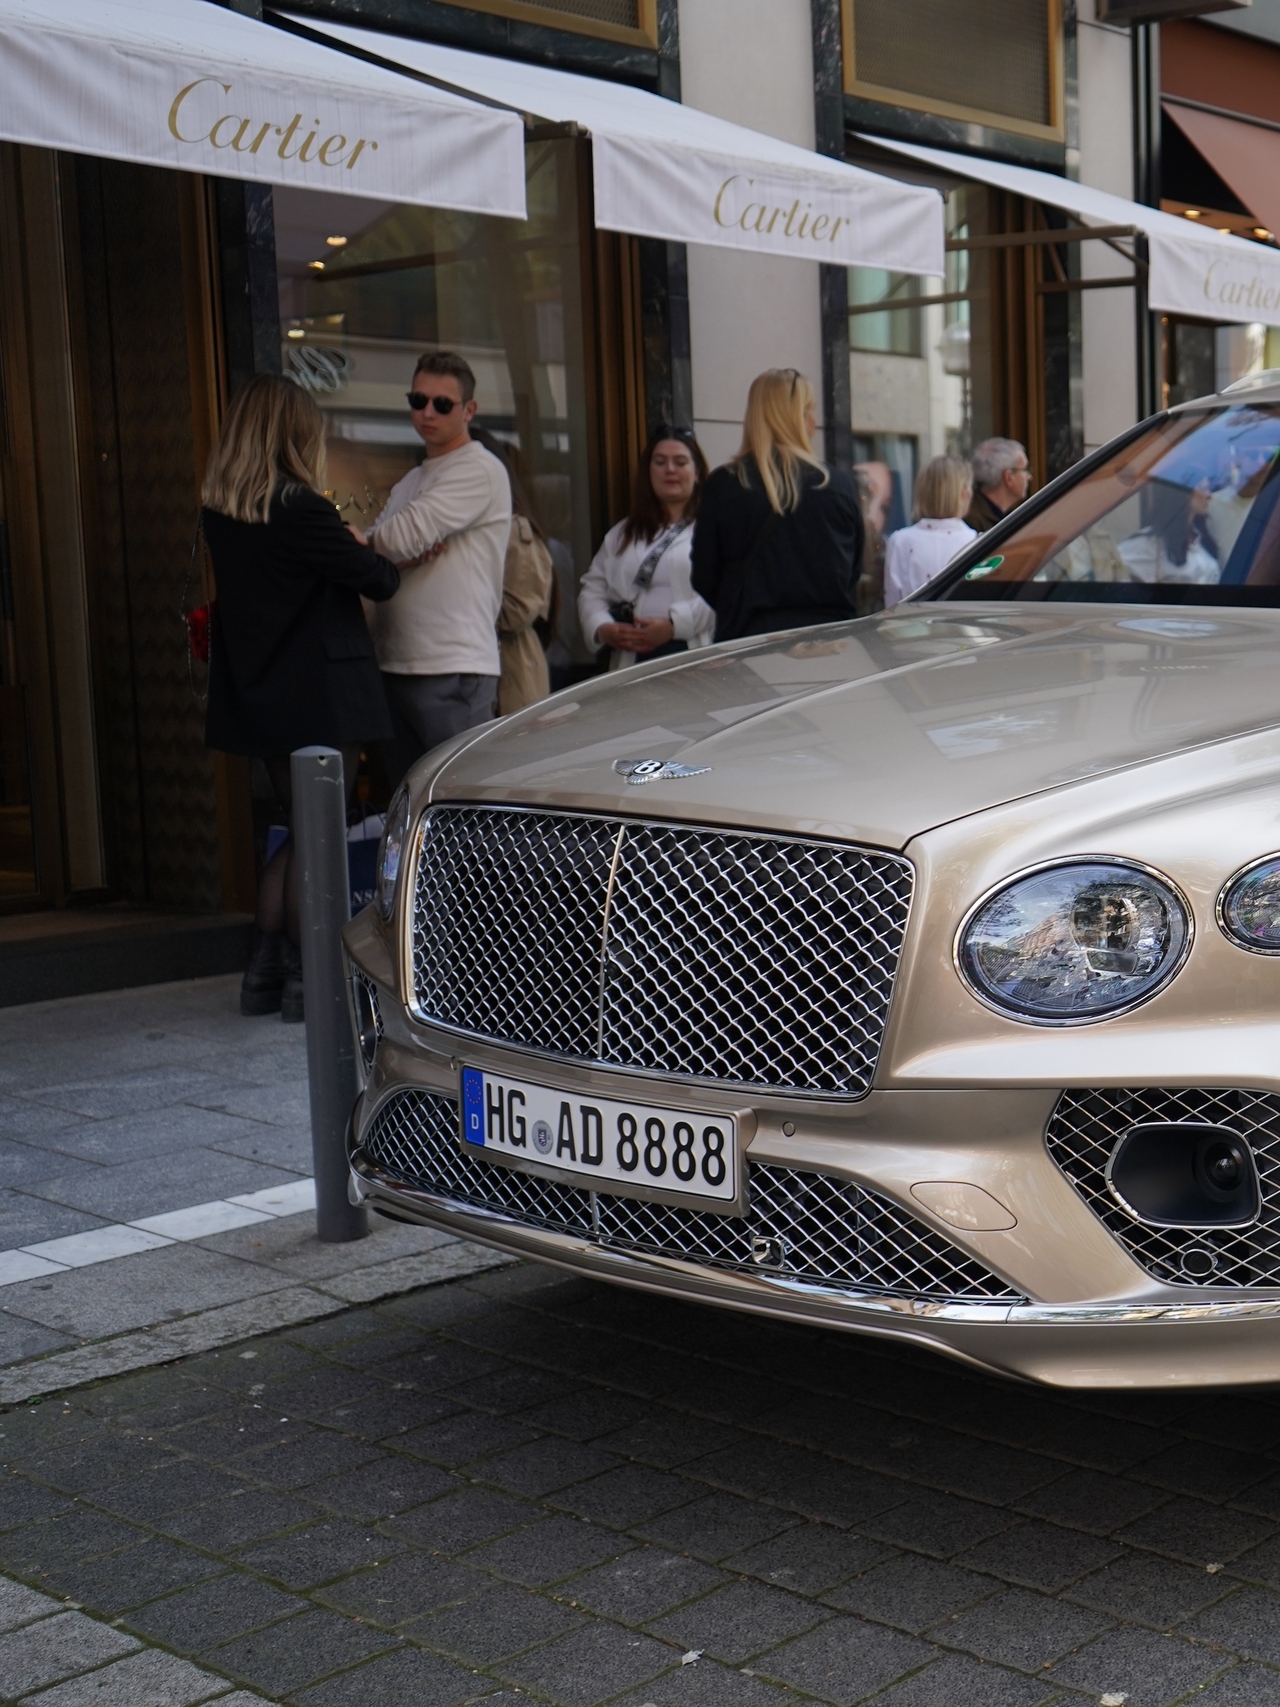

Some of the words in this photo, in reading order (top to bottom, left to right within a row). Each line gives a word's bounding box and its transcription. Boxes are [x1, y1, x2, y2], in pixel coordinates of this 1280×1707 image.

[168, 78, 378, 169] Cartier
[714, 174, 851, 242] Cartier
[471, 1113, 479, 1130] D
[486, 1082, 526, 1148] HG
[556, 1101, 603, 1166] AD
[616, 1112, 726, 1187] 8888
